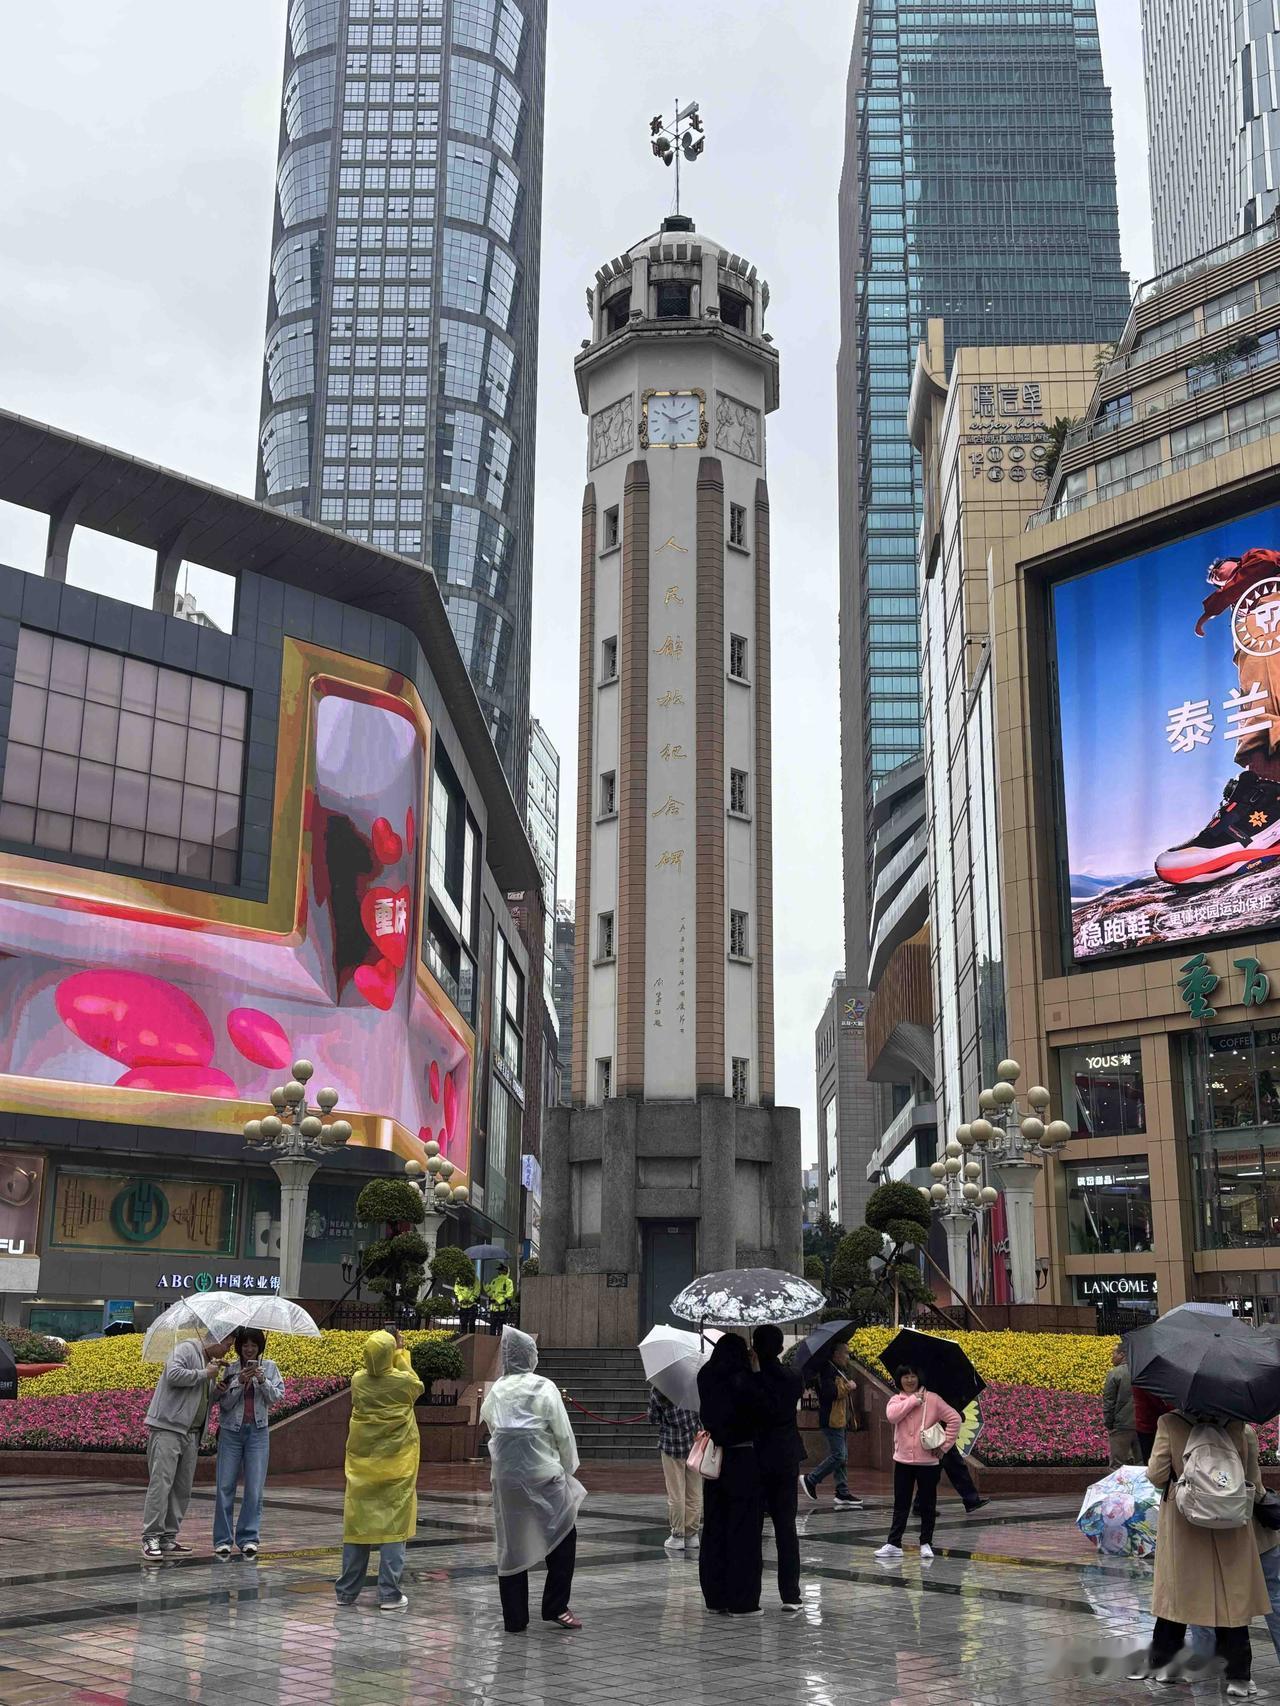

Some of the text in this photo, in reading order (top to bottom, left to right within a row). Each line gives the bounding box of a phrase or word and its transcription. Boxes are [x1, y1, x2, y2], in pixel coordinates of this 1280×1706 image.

[969, 420, 1012, 434] enjoy
[968, 452, 984, 464] 12
[973, 466, 981, 478] F
[1166, 682, 1272, 753] 泰兰
[1080, 912, 1152, 949] 稳跑鞋
[1220, 1037, 1250, 1048] COFFE
[158, 1275, 194, 1288] ABC
[1084, 1278, 1149, 1294] LANCÔME
